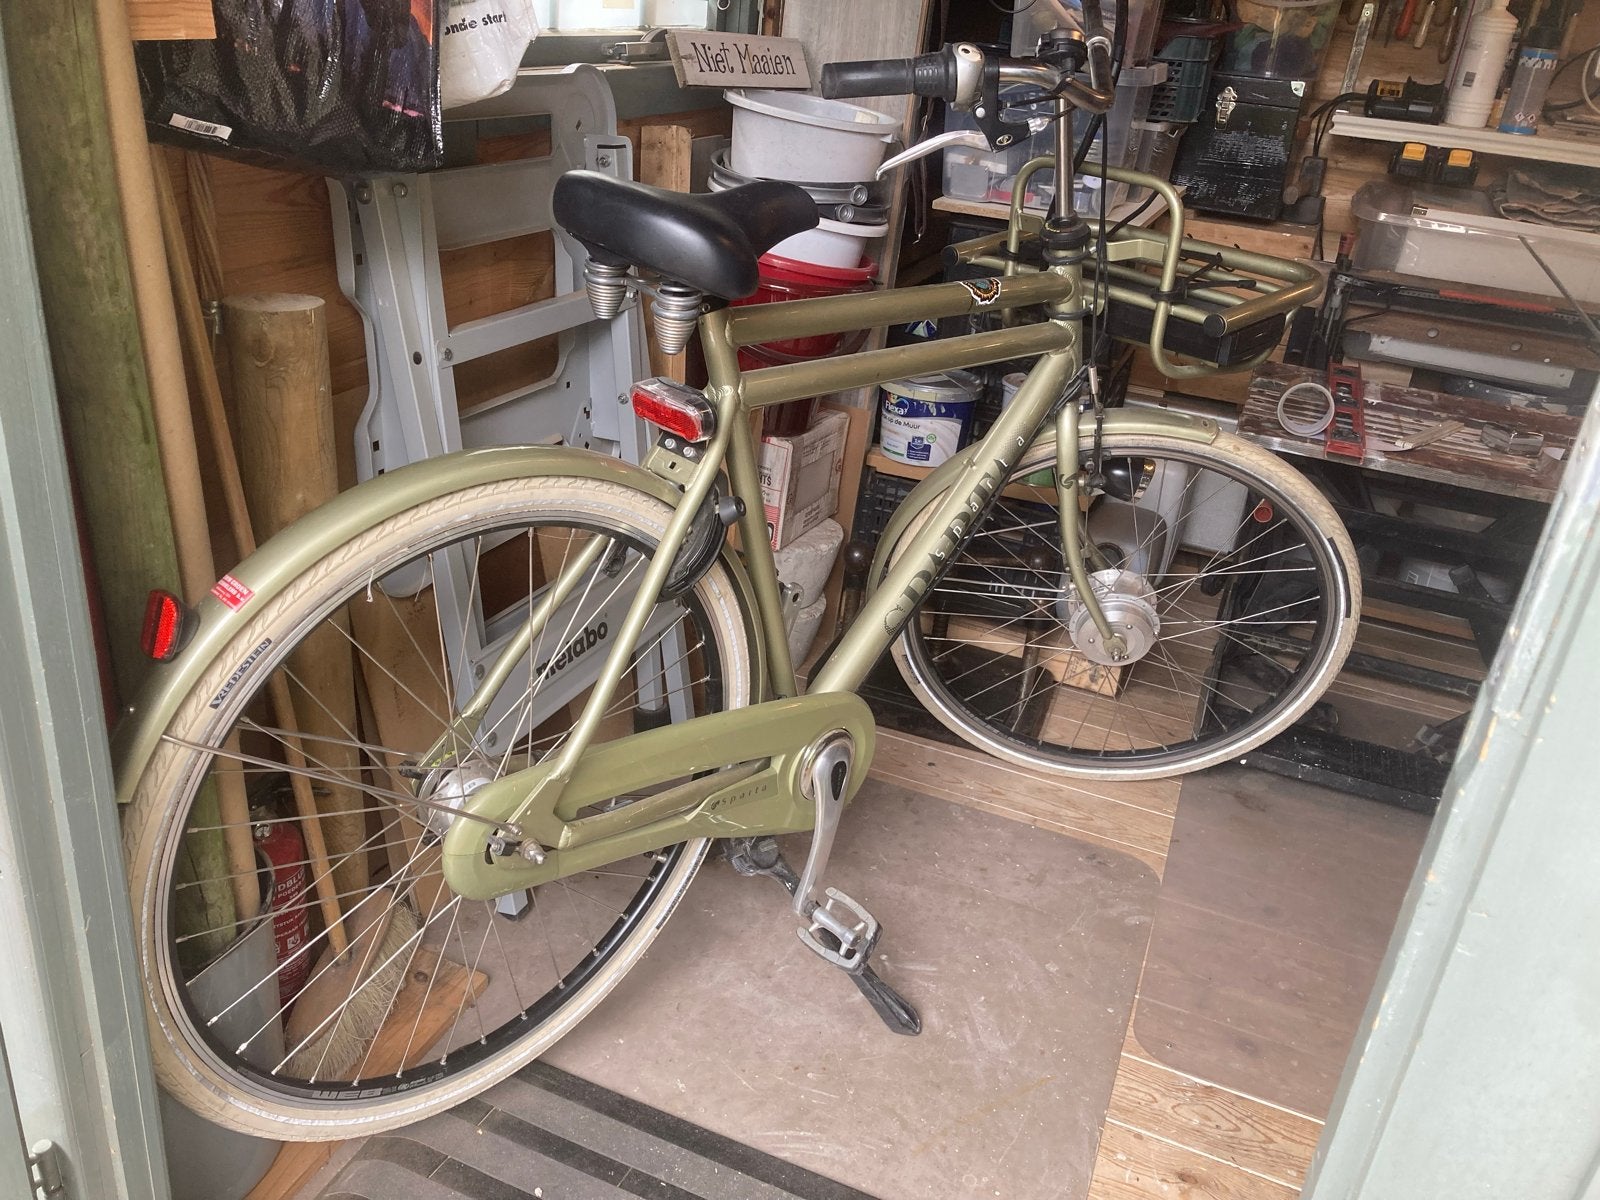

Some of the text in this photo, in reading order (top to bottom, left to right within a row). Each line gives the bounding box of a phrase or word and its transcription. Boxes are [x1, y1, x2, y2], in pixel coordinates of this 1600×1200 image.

[690, 41, 797, 75] Niet Maaien
[885, 400, 905, 416] Flexa
[903, 420, 921, 431] Muur
[536, 621, 608, 681] metabo
[211, 638, 271, 709] VREDESTEIN
